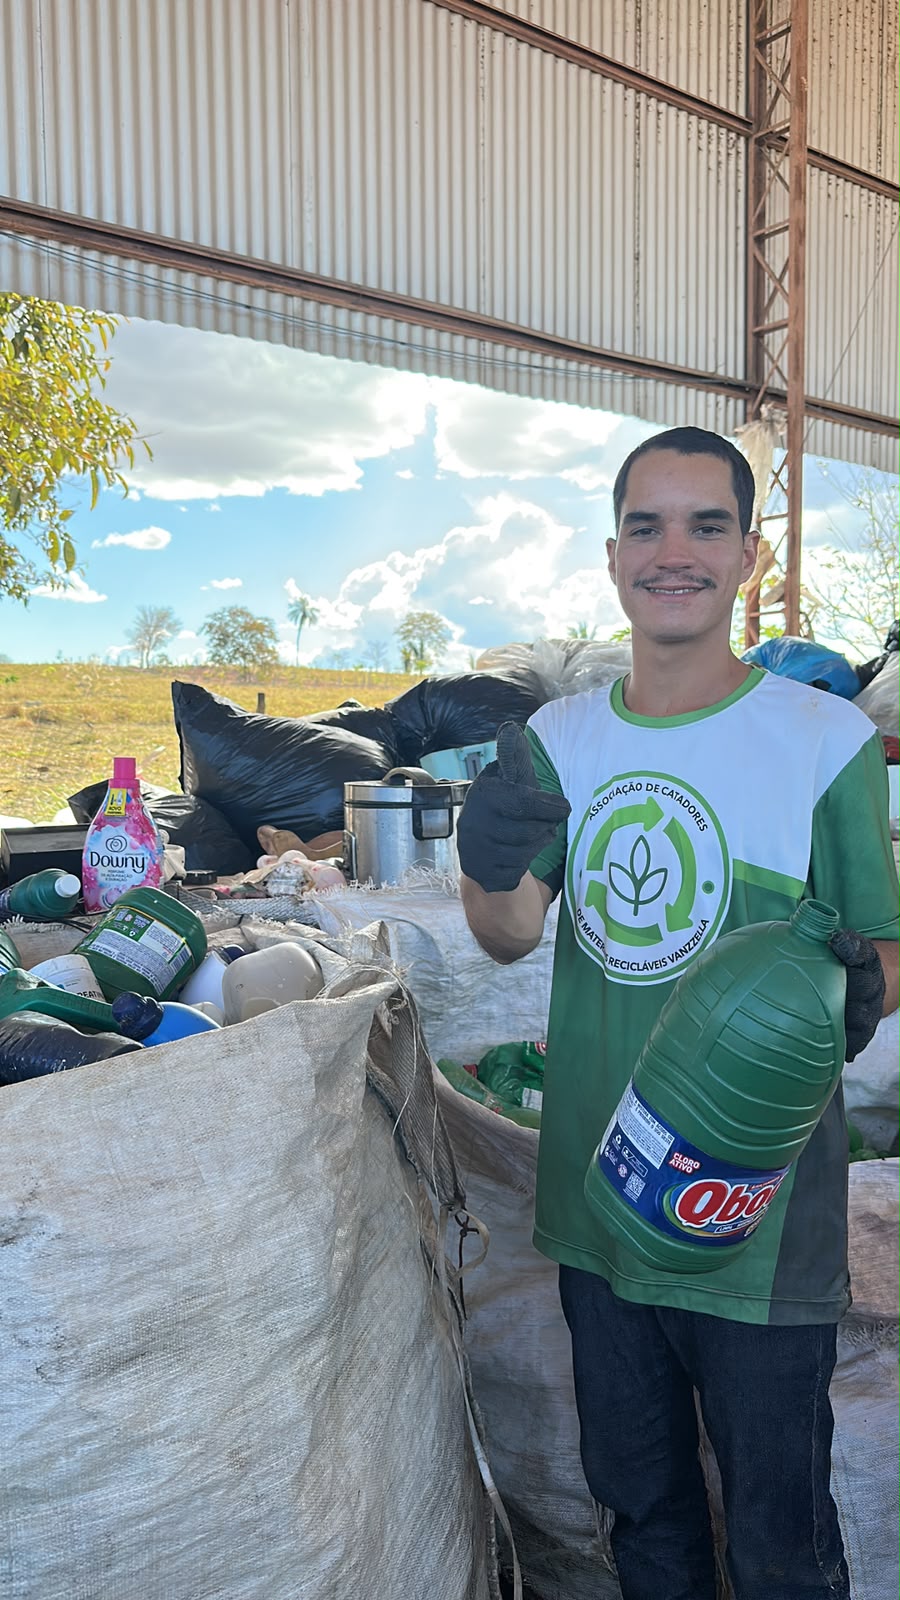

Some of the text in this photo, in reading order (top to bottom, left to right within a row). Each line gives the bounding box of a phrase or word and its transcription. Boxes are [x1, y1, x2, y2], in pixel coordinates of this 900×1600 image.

[589, 781, 708, 832] ASSOCIAÇÃO DE CATADORES
[90, 851, 145, 874] Downy
[575, 908, 586, 924] DE
[608, 956, 668, 972] RECICLÁVEIS
[667, 918, 710, 964] VANZZELLA
[669, 1159, 692, 1173] ATIVO
[673, 1152, 700, 1169] CLORO
